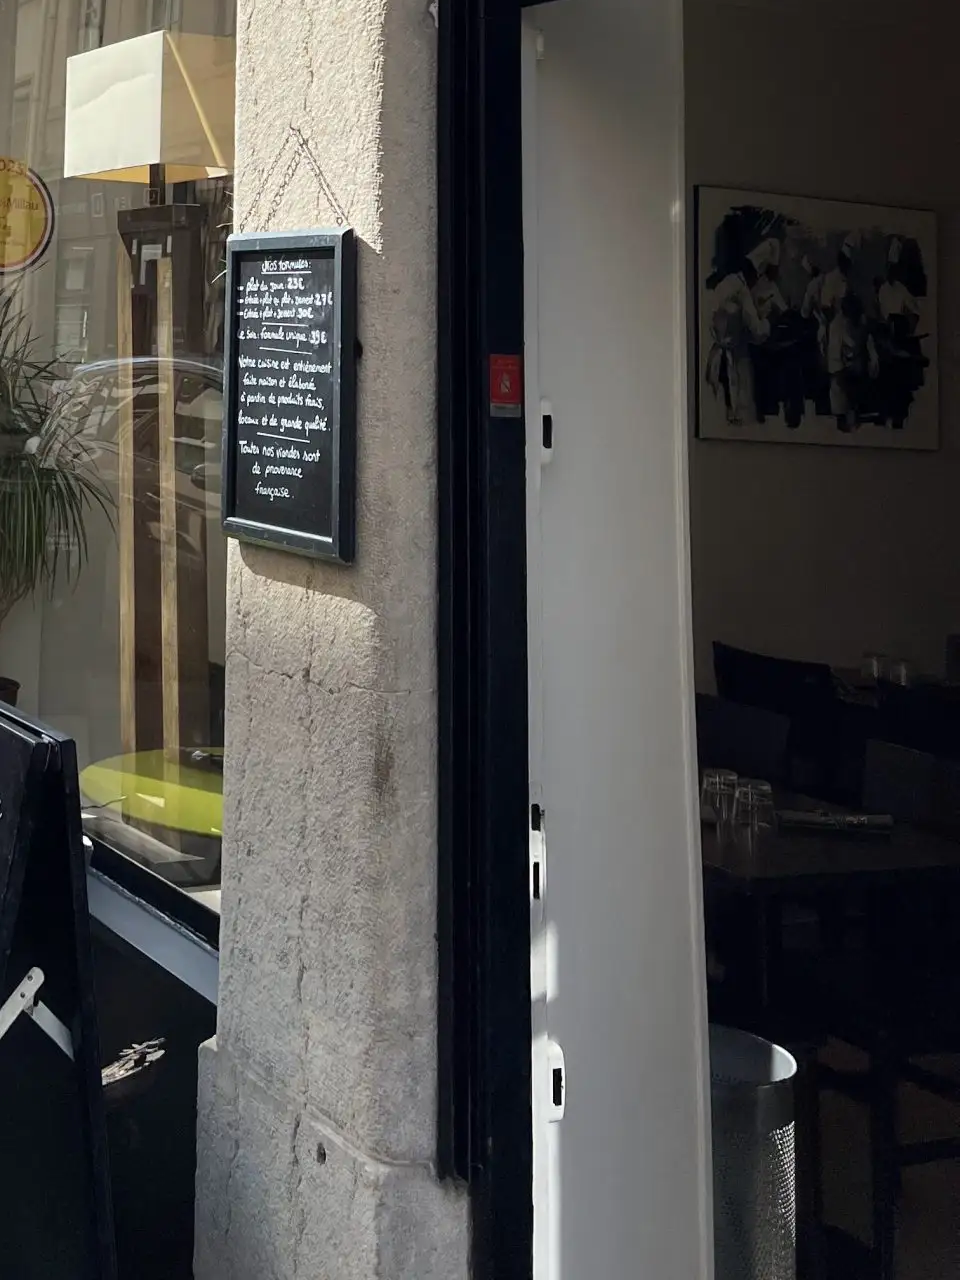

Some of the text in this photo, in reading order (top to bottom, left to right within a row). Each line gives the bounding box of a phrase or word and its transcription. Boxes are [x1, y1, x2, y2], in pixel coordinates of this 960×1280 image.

[257, 358, 279, 370] cuisine
[280, 357, 290, 370] est
[243, 372, 257, 386] faite
[258, 376, 278, 387] maison
[279, 376, 286, 388] et
[247, 391, 266, 407] partir
[268, 392, 276, 404] de
[277, 392, 303, 407] produits
[261, 414, 268, 426] et
[269, 413, 278, 426] de
[279, 416, 302, 432] grande
[239, 440, 321, 462] Toutes nos viandes sont
[251, 461, 261, 475] de
